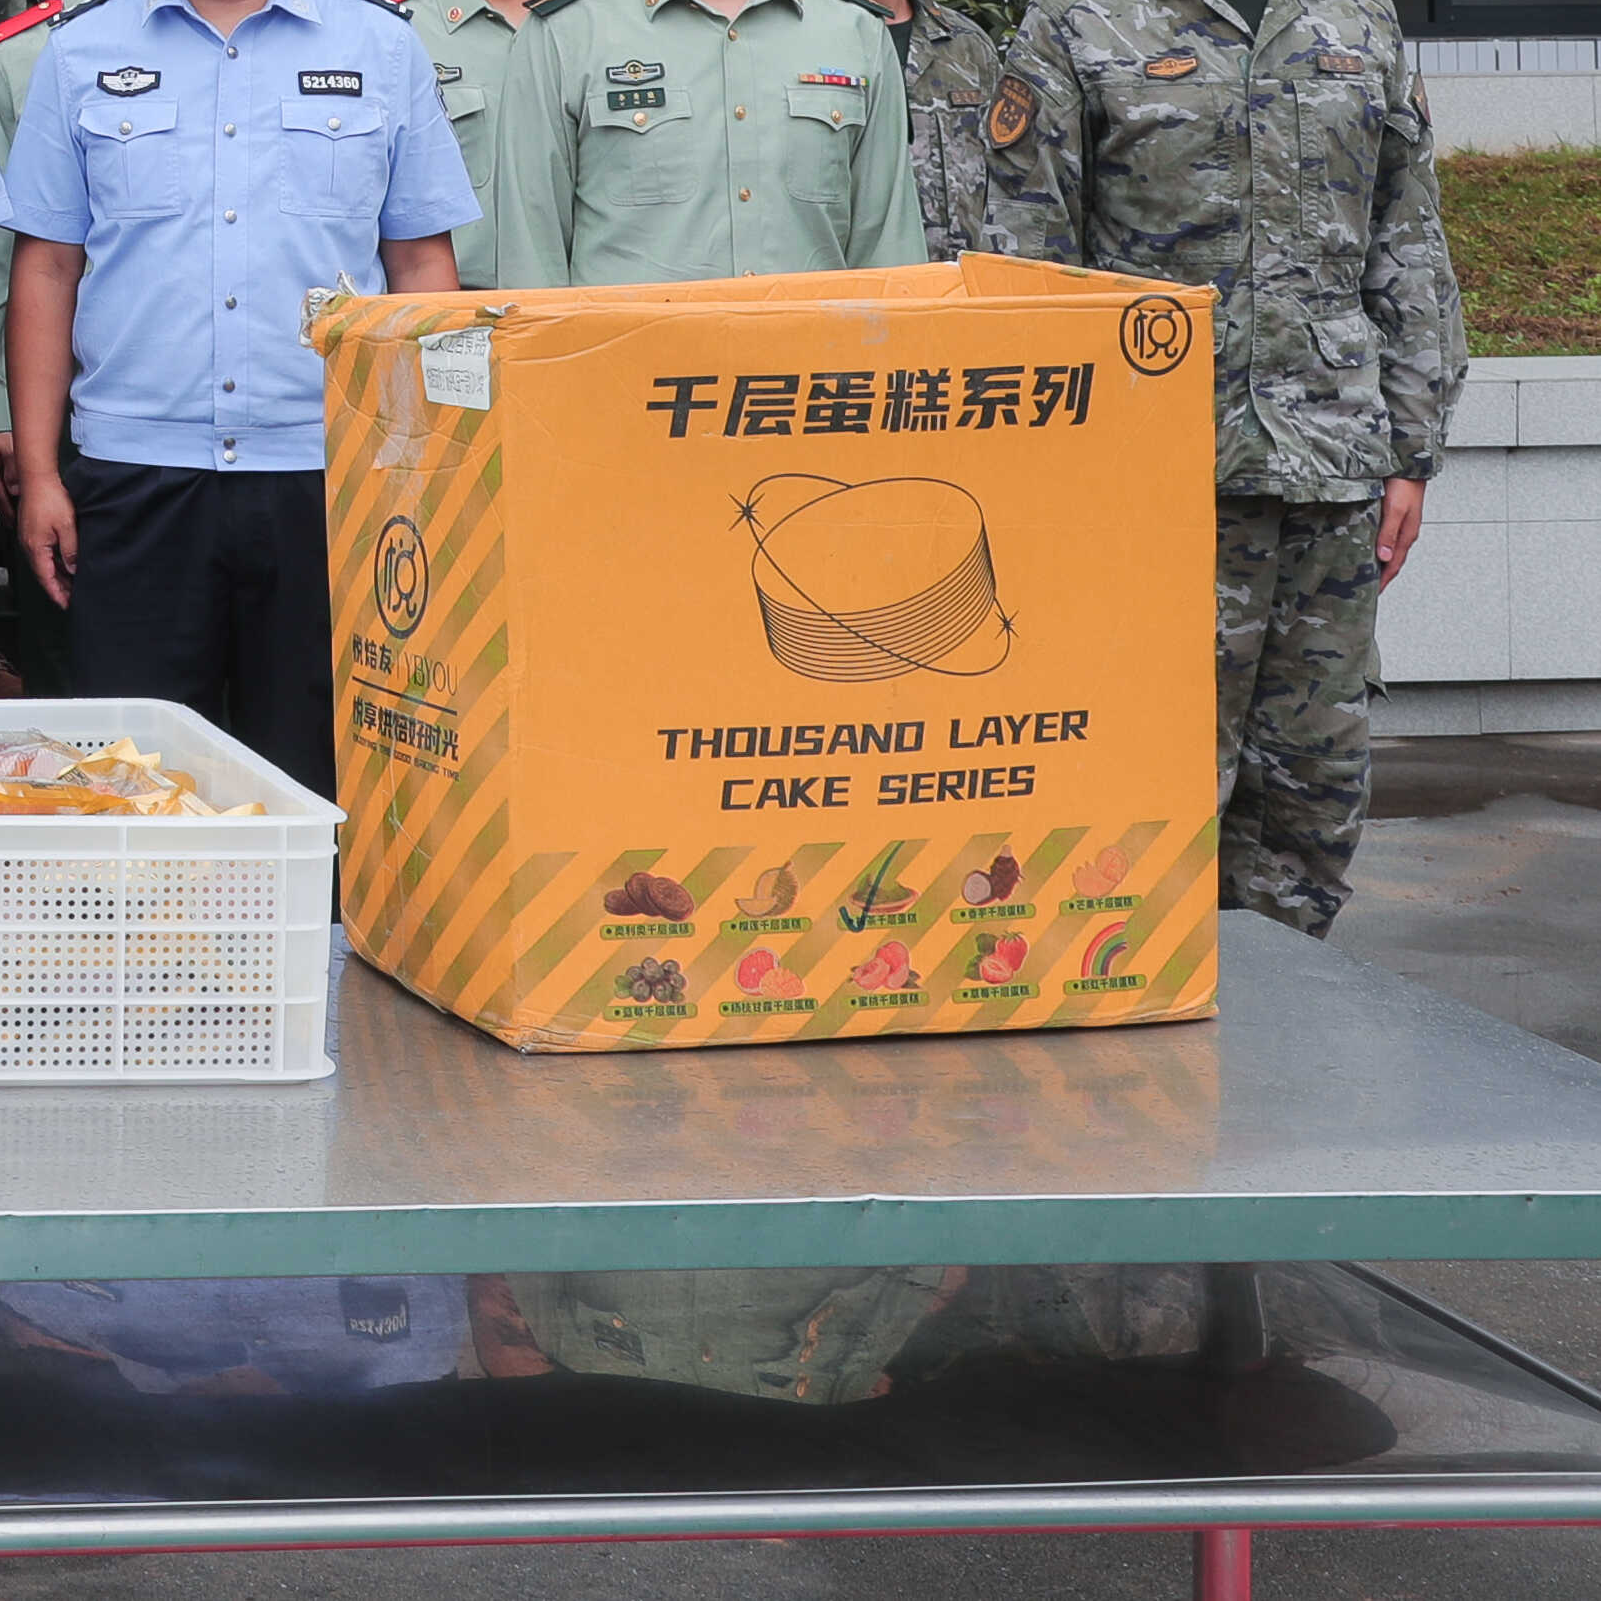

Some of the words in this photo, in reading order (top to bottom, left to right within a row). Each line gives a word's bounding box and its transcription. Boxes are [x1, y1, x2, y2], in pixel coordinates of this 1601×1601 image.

[302, 75, 360, 89] 5214360
[646, 362, 1095, 439] 千层蛋糕系列
[352, 695, 459, 762] 悦享烘焙好时光
[657, 720, 925, 760] THOUSAND
[949, 709, 1089, 749] LAYER
[721, 775, 852, 811] CAKE
[876, 764, 1036, 806] SERIES
[1076, 896, 1134, 910] 芒果千层蛋糕
[968, 904, 1026, 919] 香芋千层蛋糕
[614, 923, 689, 936] 奥利奥千层蛋糕
[1081, 975, 1137, 991] 彩虹千层蛋糕
[970, 984, 1030, 999] 草莓千层蛋糕
[859, 993, 919, 1007] 蜜桃千层蛋糕
[623, 1005, 688, 1018] 蓝莓千层蛋糕
